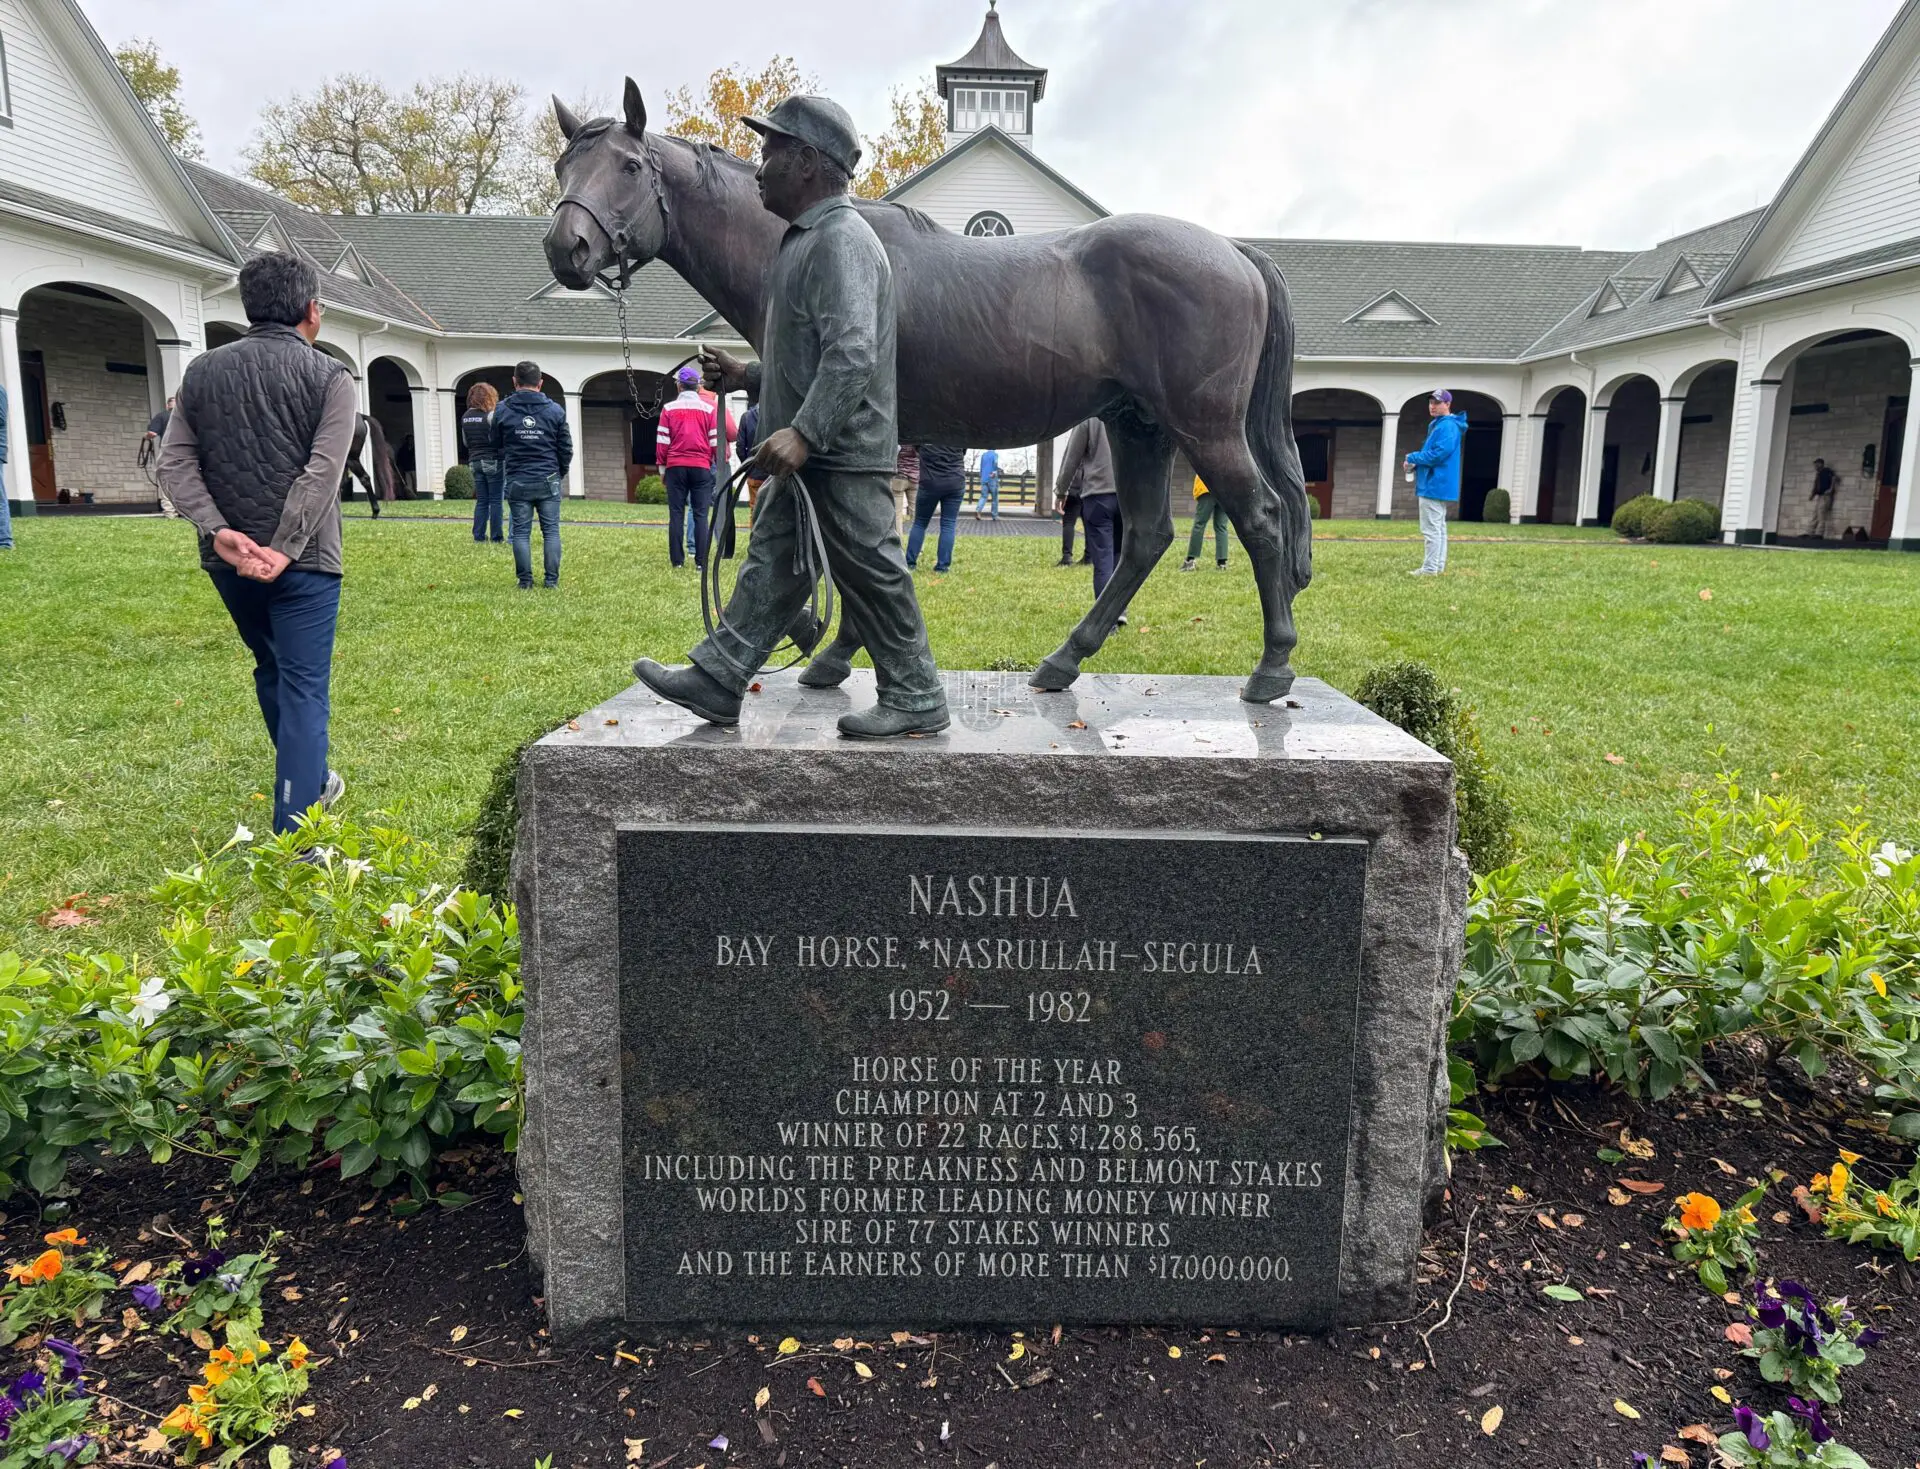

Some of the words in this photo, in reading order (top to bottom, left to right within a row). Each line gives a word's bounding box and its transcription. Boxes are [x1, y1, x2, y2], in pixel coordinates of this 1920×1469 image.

[908, 875, 1079, 917] NASHUA
[717, 935, 775, 966] BAY
[798, 936, 906, 969] HORSE,
[888, 990, 950, 1021] 1952
[1028, 992, 1091, 1022] 1982
[853, 1056, 938, 1082] HORSE
[951, 1057, 982, 1082] OF
[994, 1058, 1043, 1083] THE
[1054, 1059, 1122, 1085] YEAR
[836, 1089, 979, 1115] CHAMPION
[991, 1092, 1022, 1116] AT
[1034, 1091, 1046, 1116] 2
[1059, 1093, 1114, 1117] AND
[1126, 1093, 1138, 1118] 3
[777, 1122, 885, 1147] WINNER
[897, 1122, 928, 1147] OF
[938, 1122, 965, 1148] 22
[644, 1155, 795, 1180] INCLUDING
[806, 1156, 854, 1180] THE
[868, 1156, 1018, 1182] PREAKNESS
[1030, 1158, 1085, 1182] AND
[1097, 1159, 1220, 1185] BELMONT
[1230, 1160, 1322, 1187] STAKES
[820, 1188, 925, 1213] FORMER
[939, 1189, 1051, 1214] LEADING
[1064, 1189, 1155, 1215] MONEY
[1168, 1191, 1271, 1218] WINNER
[796, 1220, 853, 1244] SIRE
[865, 1219, 896, 1244] OF
[908, 1220, 935, 1243] 77
[947, 1220, 1040, 1245] STAKES
[1051, 1222, 1170, 1247] WINNERS
[677, 1251, 732, 1275] AND
[743, 1252, 792, 1275] THE
[805, 1252, 921, 1276] EARNERS
[935, 1252, 965, 1276] OF
[978, 1252, 1050, 1278] MORE
[1061, 1254, 1129, 1278] THAN
